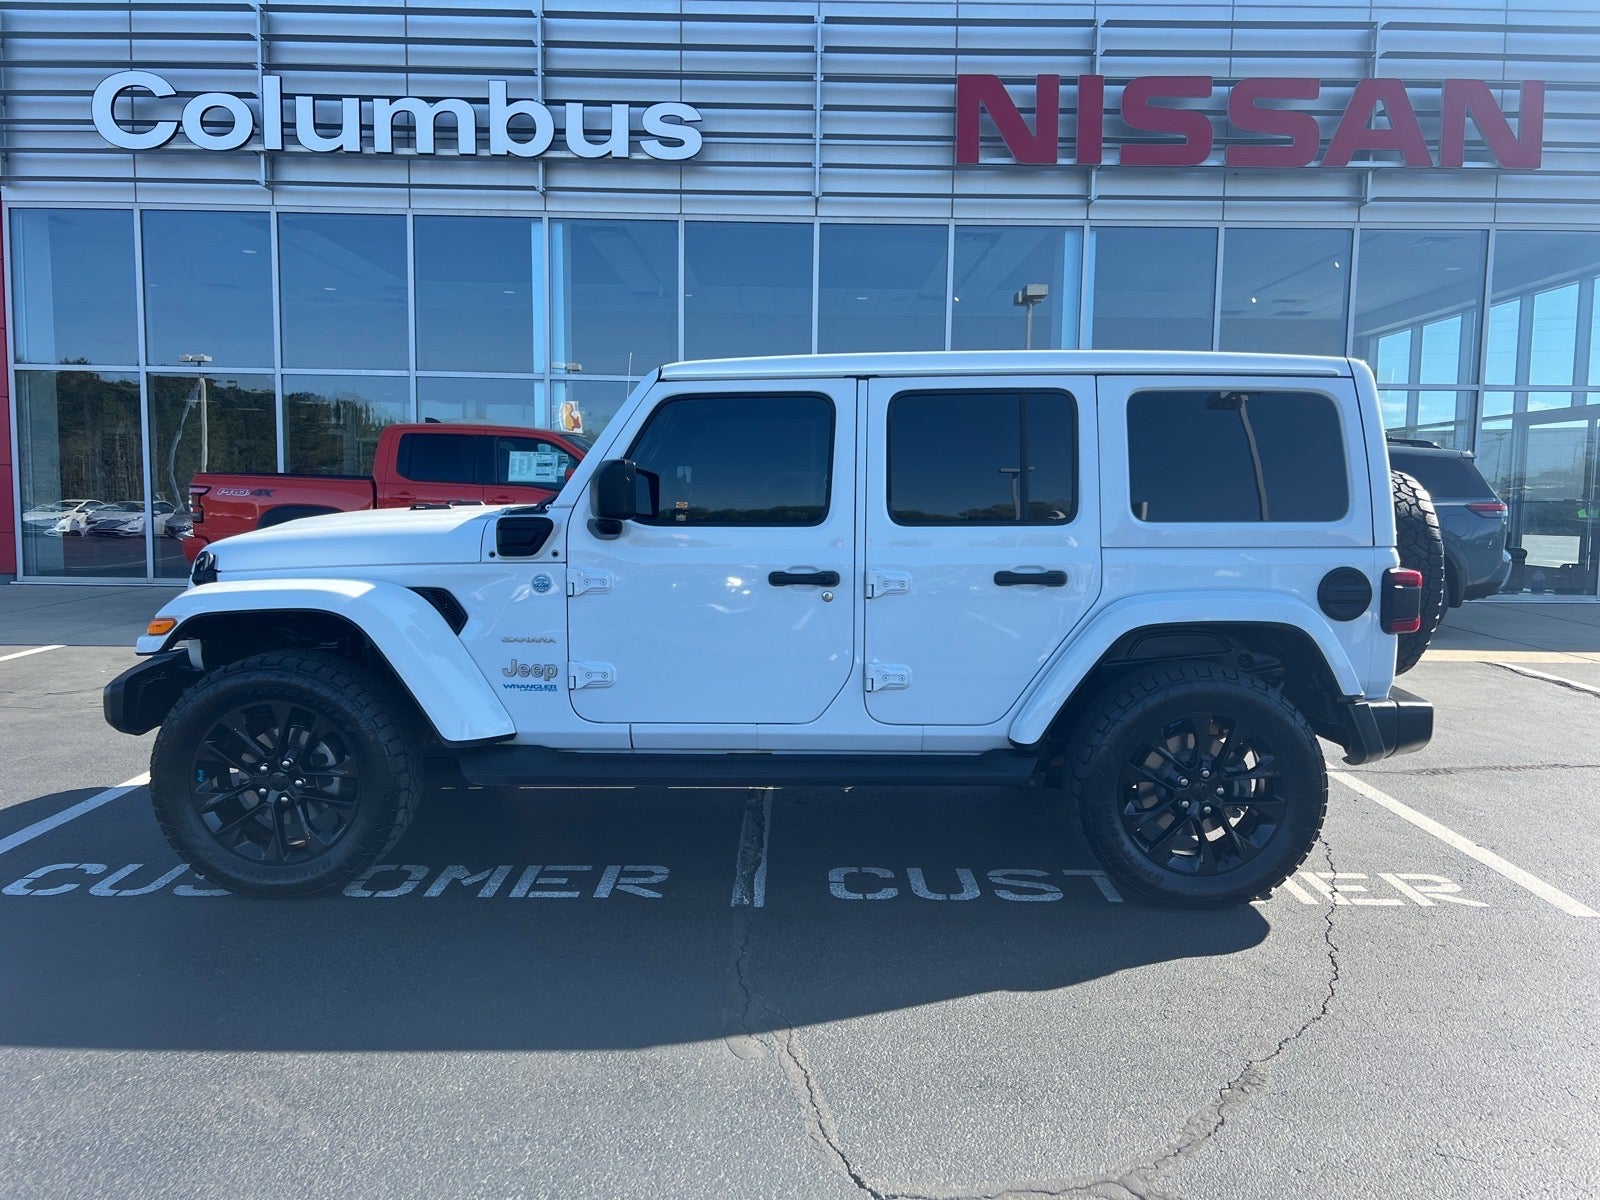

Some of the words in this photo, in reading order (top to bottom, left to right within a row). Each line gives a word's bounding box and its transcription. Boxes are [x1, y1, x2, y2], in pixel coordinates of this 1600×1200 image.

[91, 70, 704, 162] Columbus
[955, 74, 1546, 171] NISSAN
[502, 658, 558, 681] Jeep
[828, 866, 1490, 908] CUSTER
